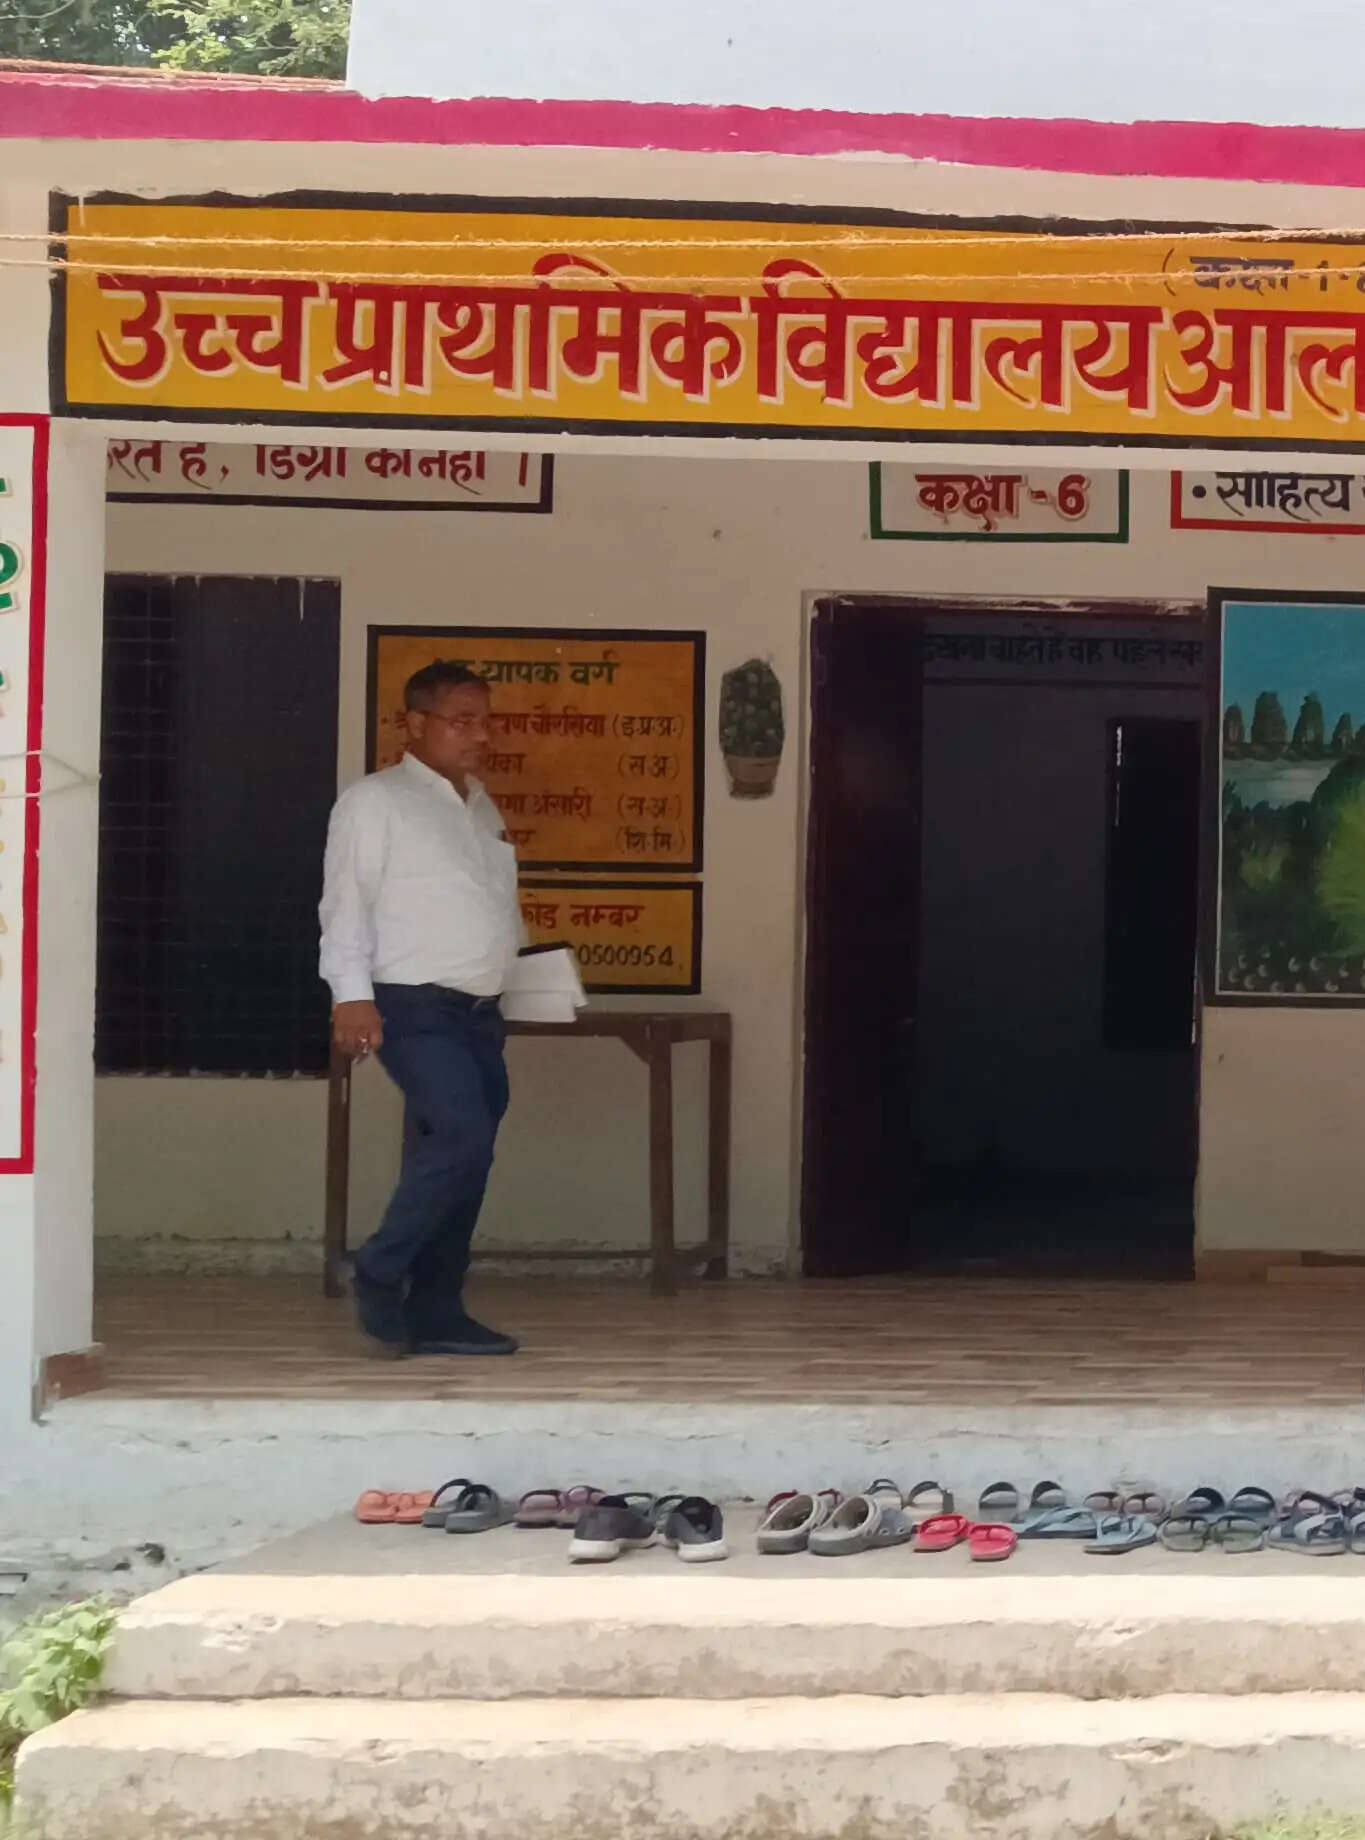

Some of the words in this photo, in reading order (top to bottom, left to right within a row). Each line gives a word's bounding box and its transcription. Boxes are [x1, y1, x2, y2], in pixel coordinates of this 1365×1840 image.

[97, 273, 320, 390] उच्च
[321, 253, 750, 402] प्राथमिक
[749, 258, 1166, 418] विद्यालय
